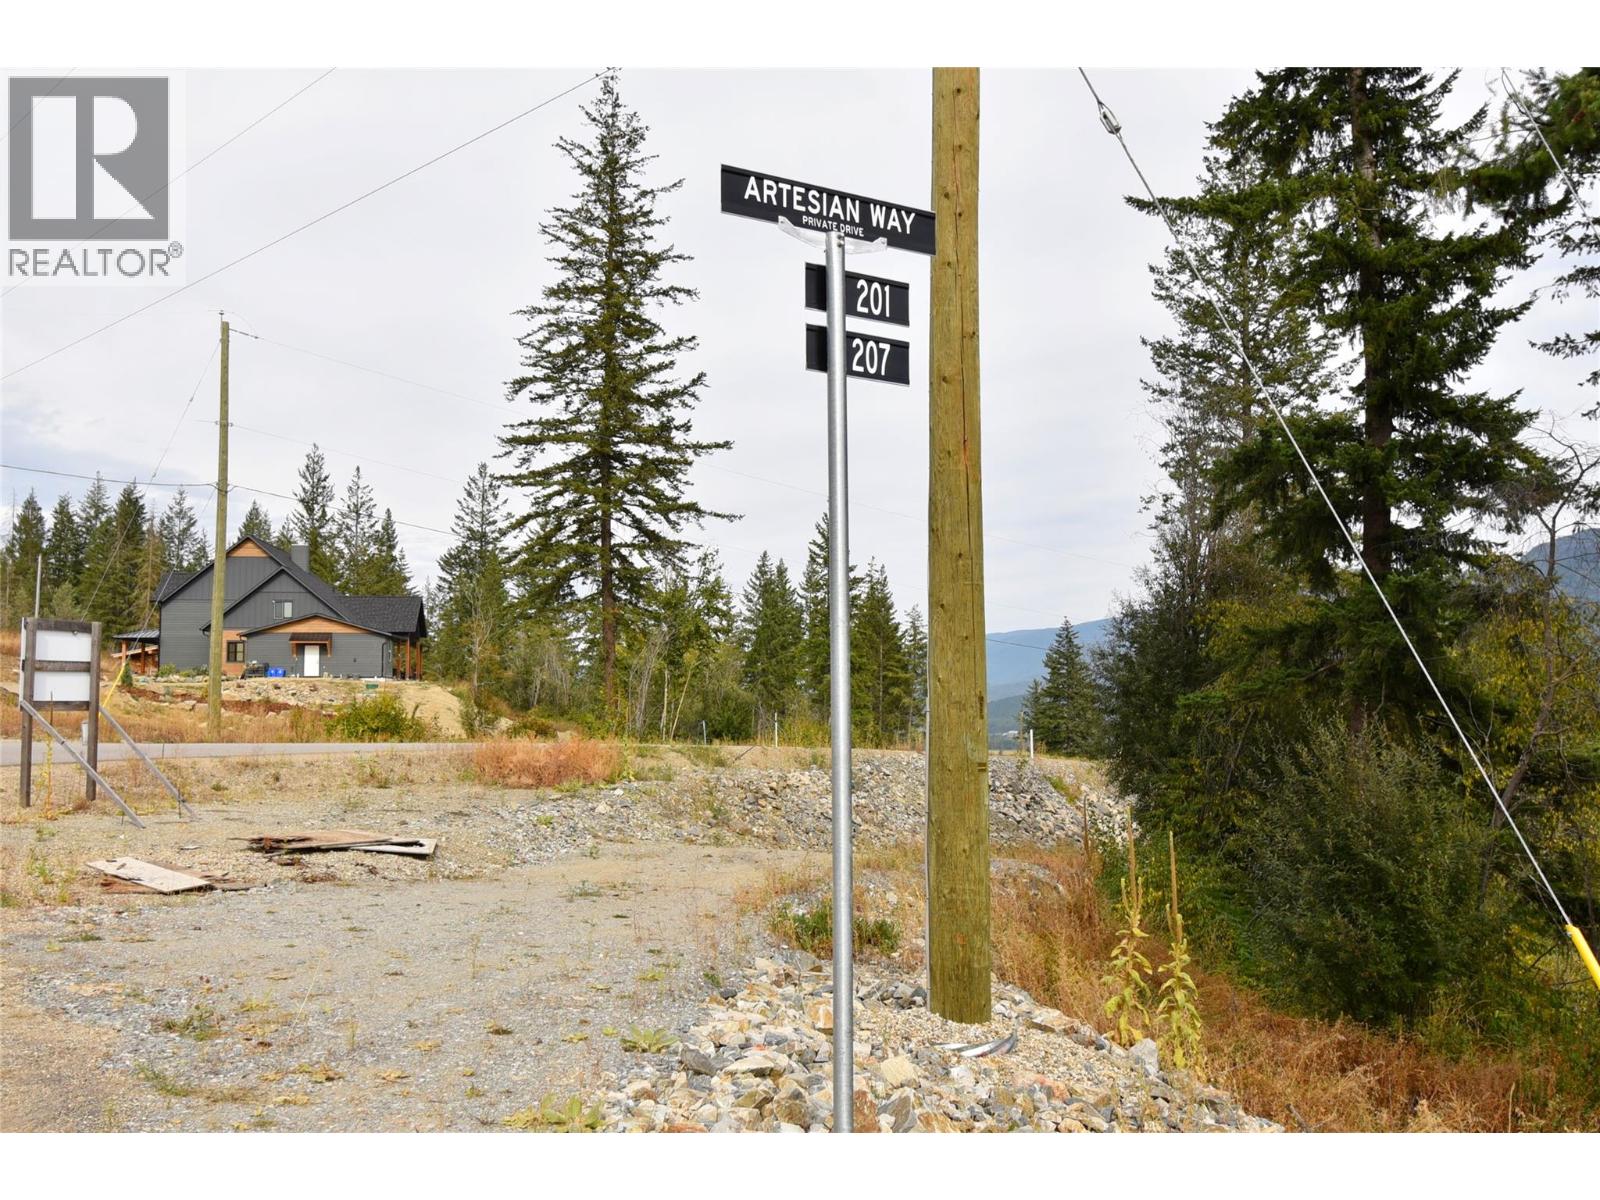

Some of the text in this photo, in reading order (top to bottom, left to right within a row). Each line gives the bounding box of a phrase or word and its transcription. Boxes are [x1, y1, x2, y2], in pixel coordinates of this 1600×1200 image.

[744, 176, 916, 234] ARTESIAN WAY
[802, 215, 864, 237] PRIVATE DRIVE
[856, 279, 890, 318] 201
[852, 338, 891, 376] 207
